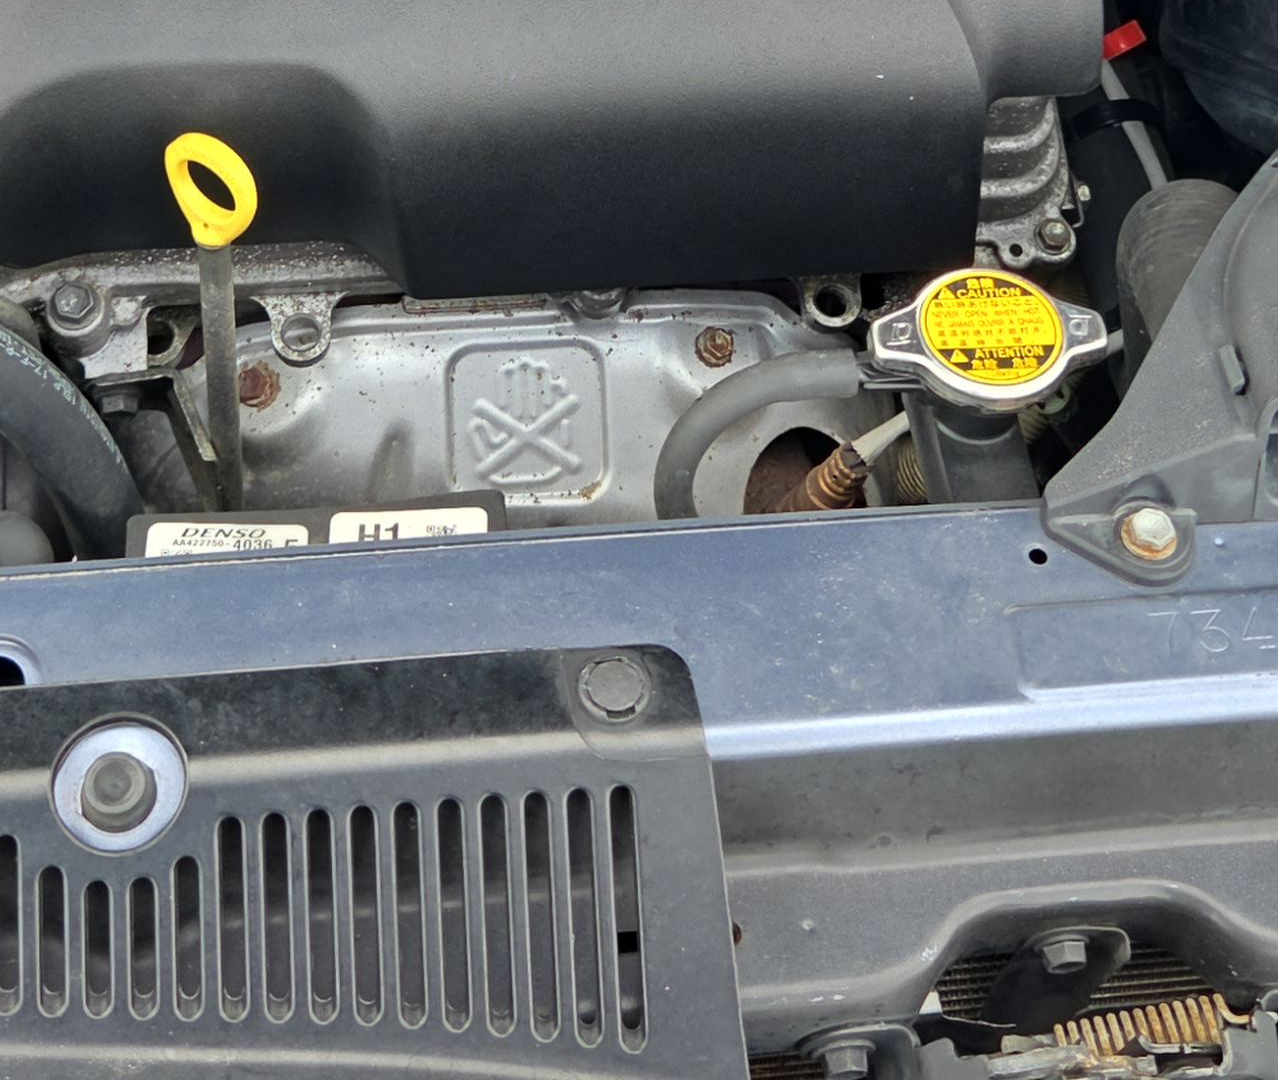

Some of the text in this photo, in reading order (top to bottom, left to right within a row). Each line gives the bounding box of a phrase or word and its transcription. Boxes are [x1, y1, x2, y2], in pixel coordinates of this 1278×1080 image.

[956, 287, 1021, 298] CAUTION
[975, 346, 1044, 359] ATTENTION
[181, 528, 266, 538] DENSO
